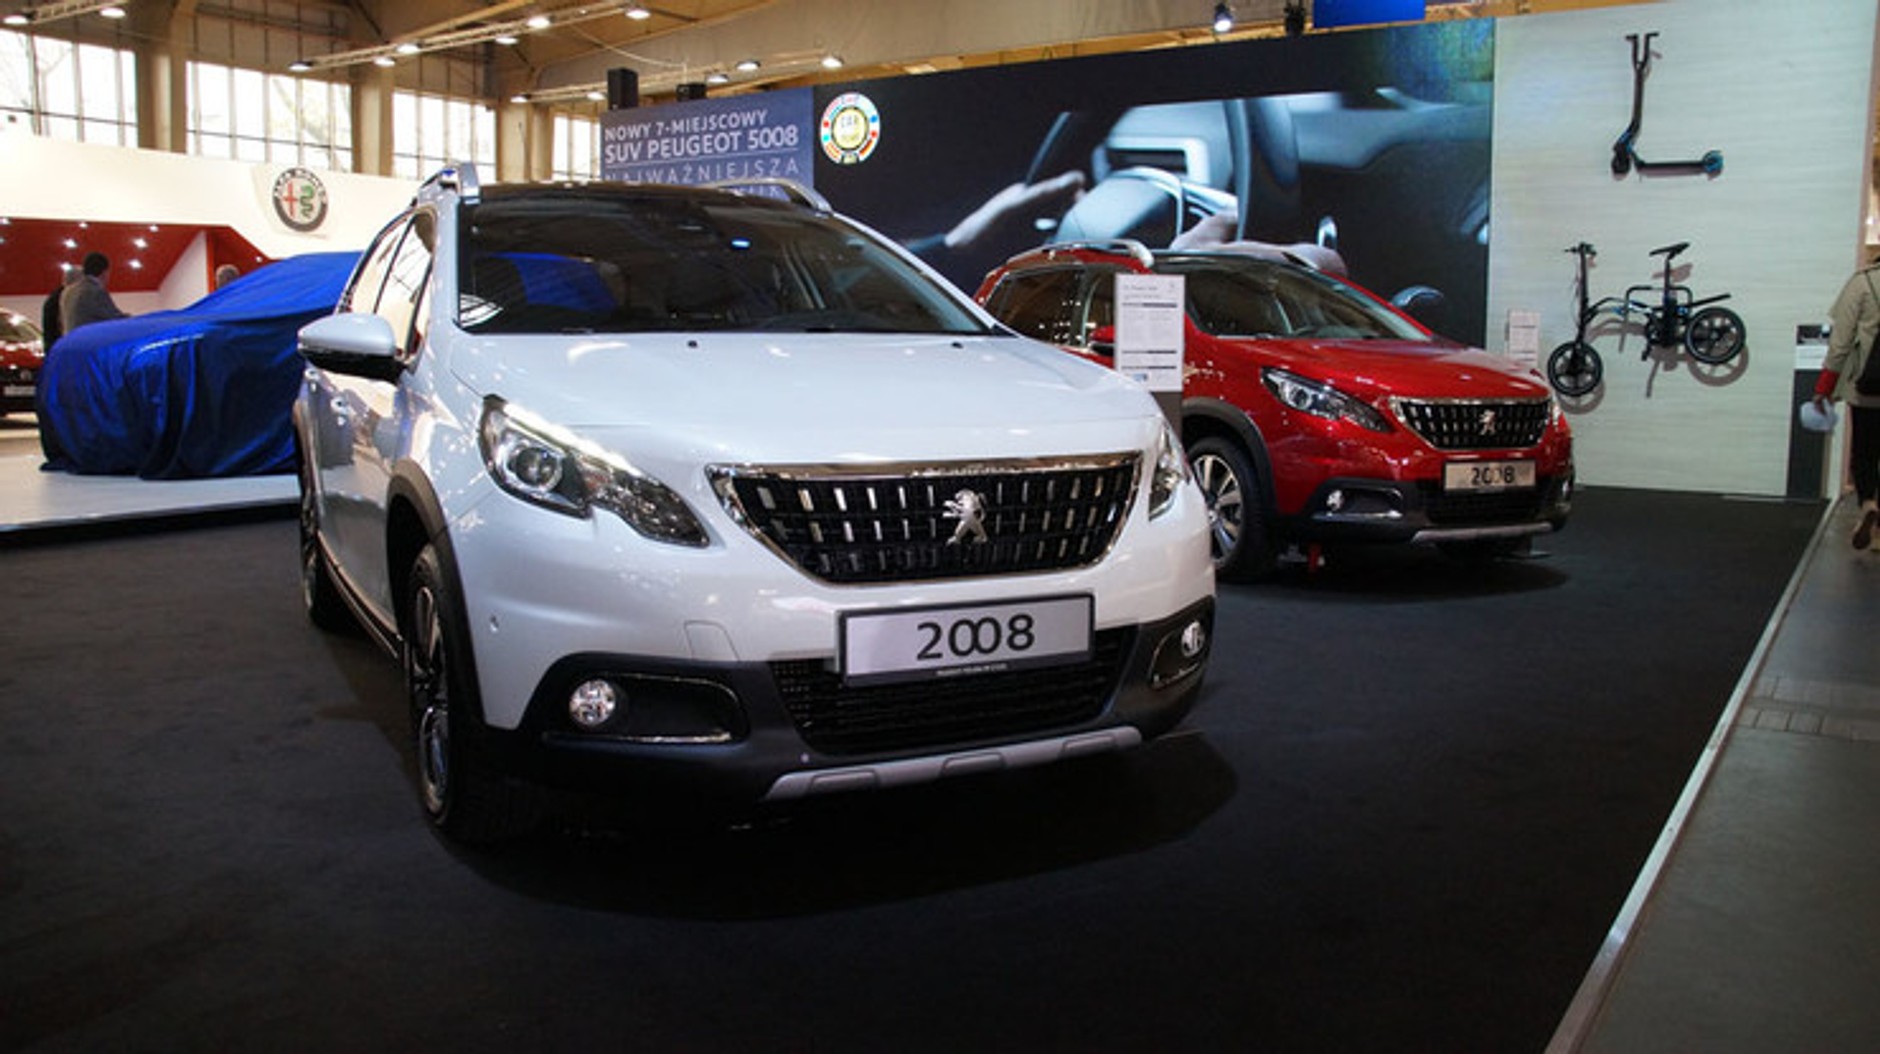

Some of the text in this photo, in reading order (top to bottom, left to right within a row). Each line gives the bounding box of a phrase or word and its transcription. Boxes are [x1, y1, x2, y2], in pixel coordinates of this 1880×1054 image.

[605, 110, 767, 142] NOWY 7-MIEJSCOWY
[605, 125, 798, 163] SUV PEUGEOT 5008
[916, 613, 1034, 661] 2008
